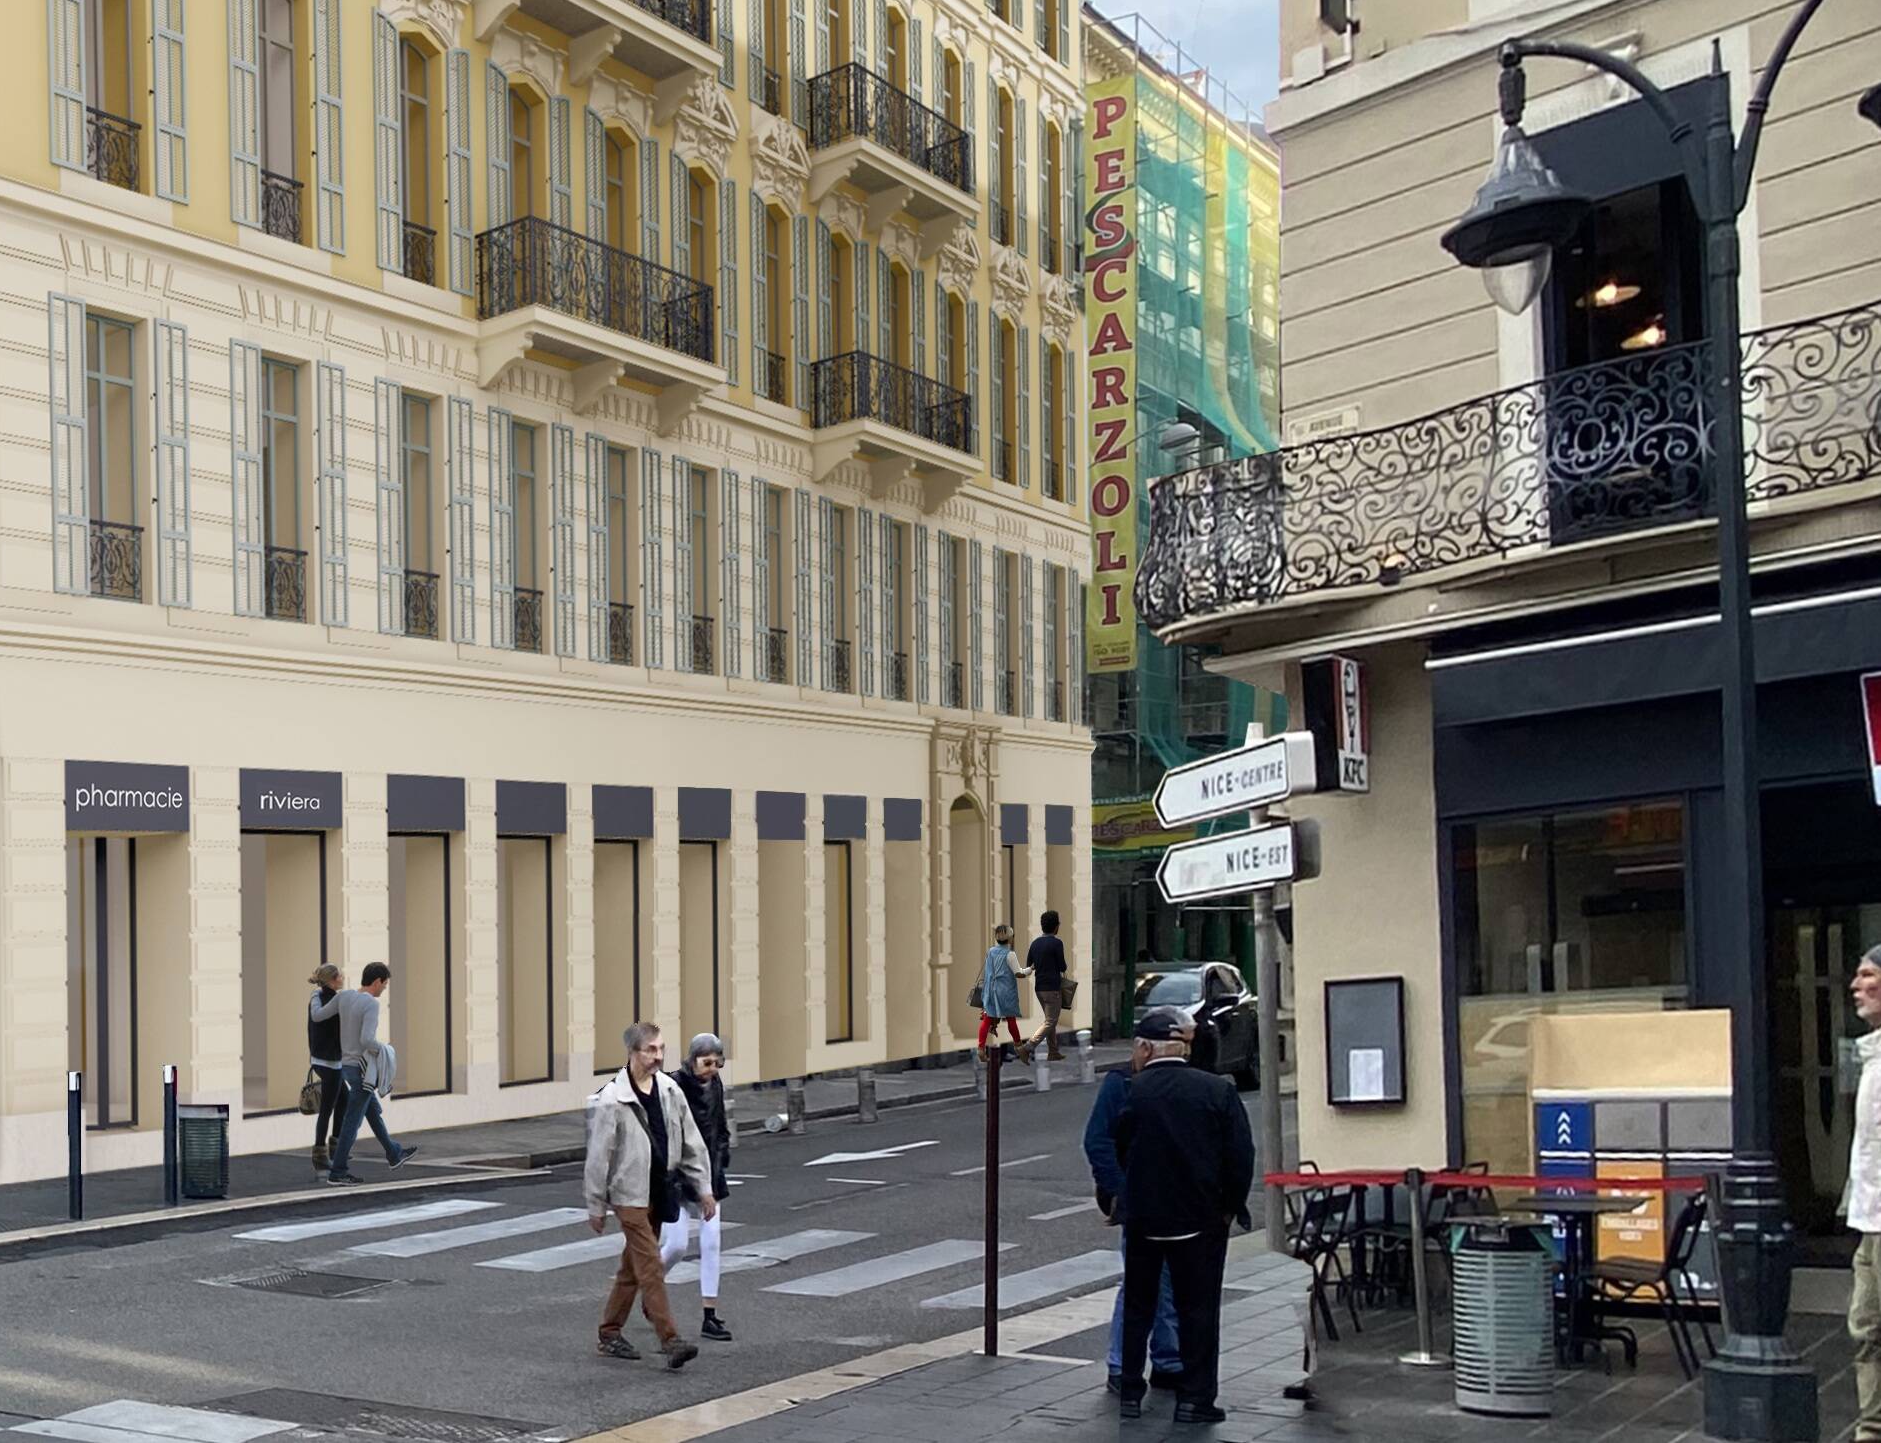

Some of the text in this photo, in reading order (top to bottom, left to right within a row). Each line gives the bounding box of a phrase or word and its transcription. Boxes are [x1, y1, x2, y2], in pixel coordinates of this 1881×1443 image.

[1088, 94, 1134, 626] PESCARZOLI
[1201, 760, 1284, 800] NICE-CENTRE
[1343, 756, 1365, 786] KFC
[75, 783, 183, 812] pharmacie
[260, 790, 320, 810] riviera
[1226, 844, 1289, 874] NICE-EST
